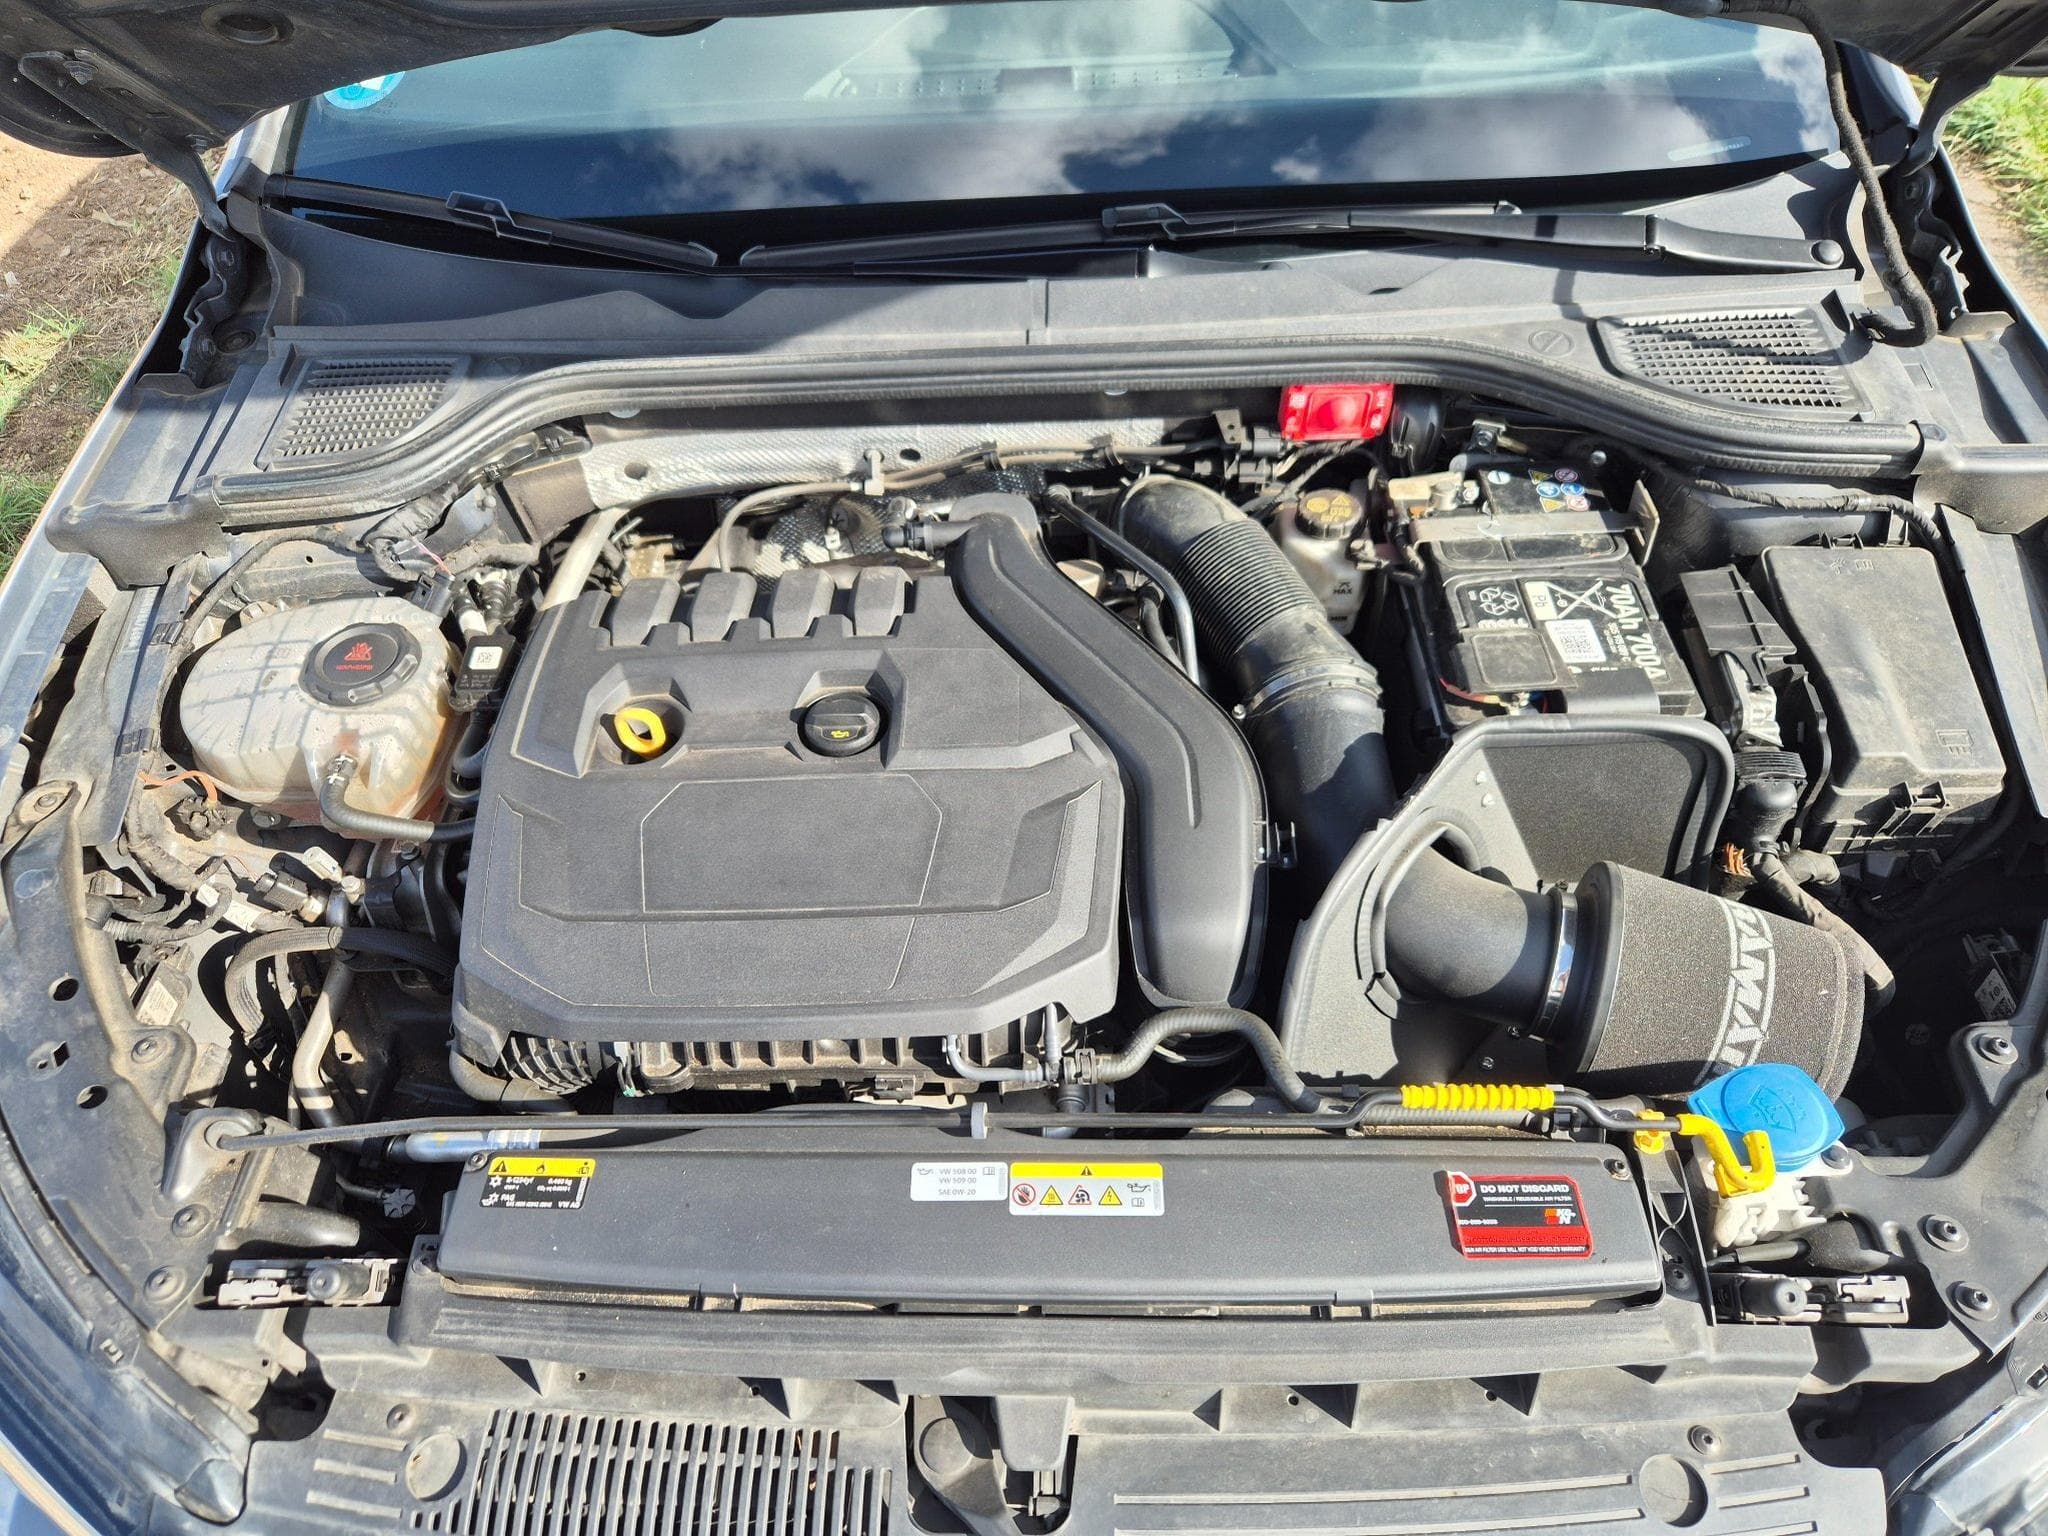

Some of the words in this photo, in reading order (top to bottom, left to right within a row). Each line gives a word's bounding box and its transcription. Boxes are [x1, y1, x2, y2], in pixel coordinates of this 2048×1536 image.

[1606, 585, 1640, 630] 70Ah
[1480, 1184, 1496, 1193] DO
[1498, 1184, 1520, 1193] NOT
[1522, 1184, 1569, 1193] DISCARD
